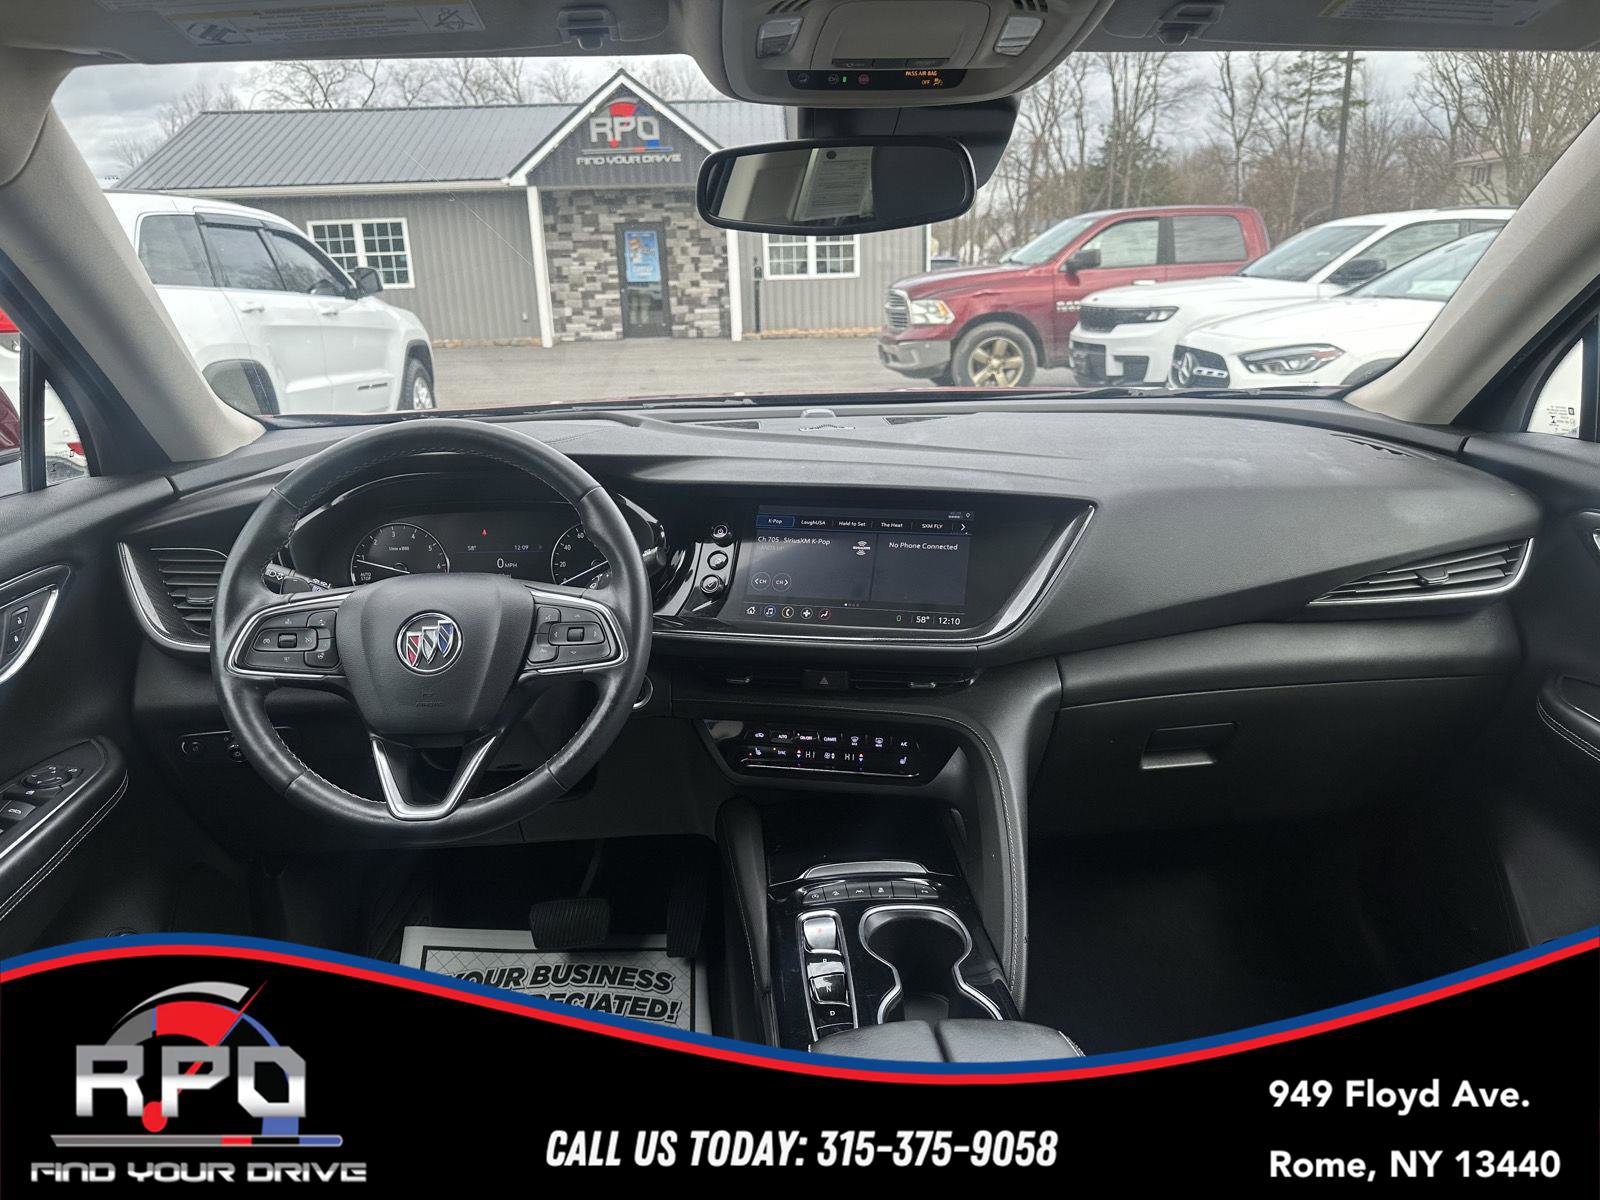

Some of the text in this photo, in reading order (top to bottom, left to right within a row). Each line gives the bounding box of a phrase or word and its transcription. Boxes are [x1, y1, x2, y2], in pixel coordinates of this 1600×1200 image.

[576, 154, 682, 165] FIND YOUR DRIVE
[783, 537, 810, 545] SiriusXM
[812, 538, 831, 546] K-Pop
[497, 558, 504, 568] 0
[938, 617, 961, 626] 12:10
[529, 964, 675, 994] BUSINESS
